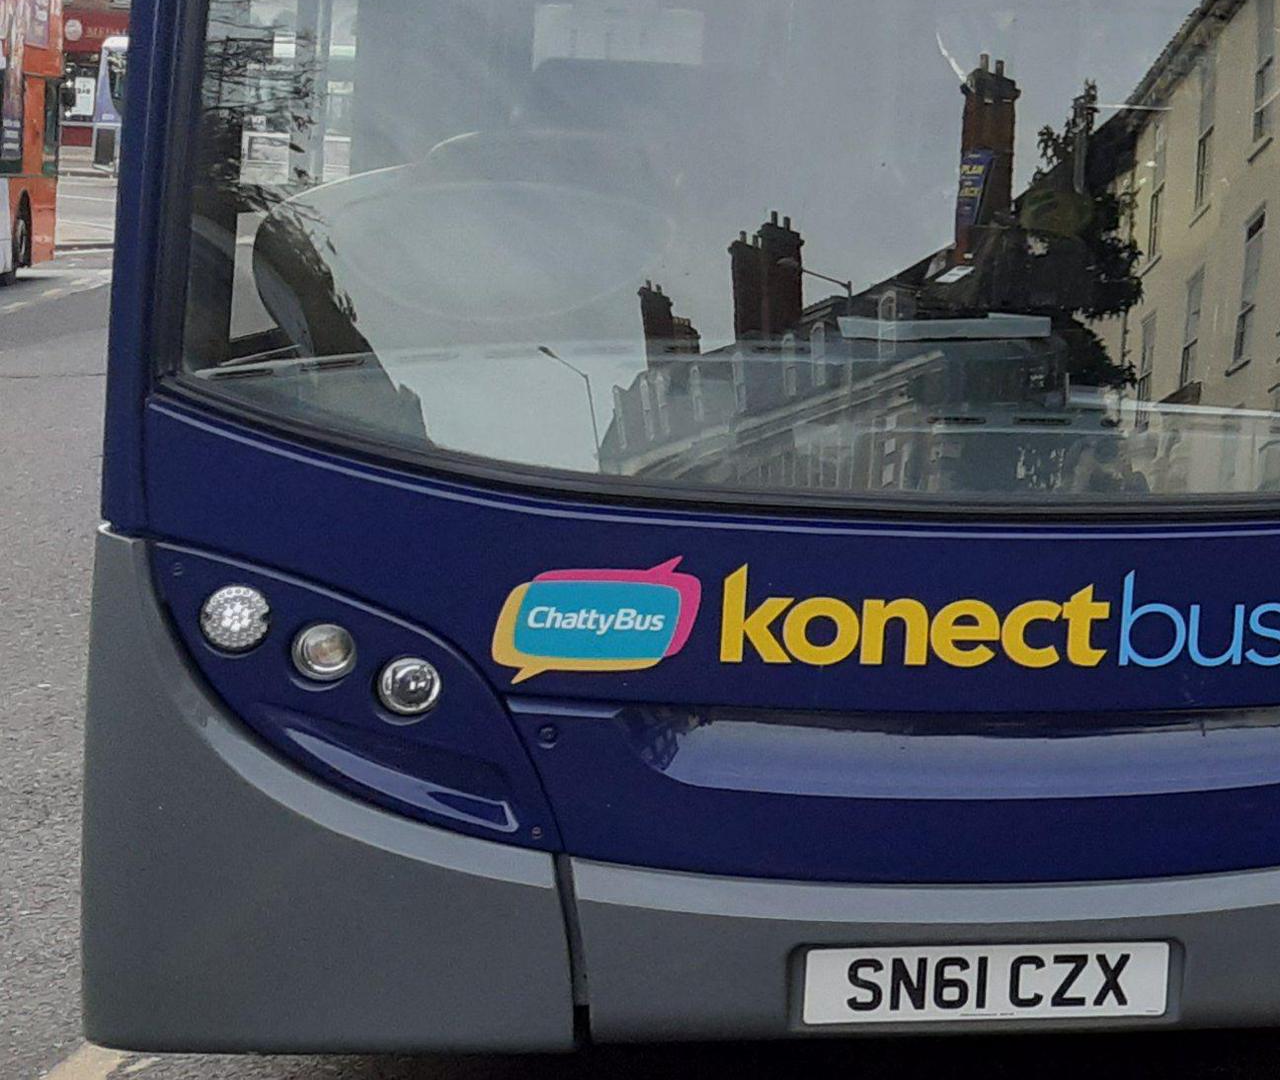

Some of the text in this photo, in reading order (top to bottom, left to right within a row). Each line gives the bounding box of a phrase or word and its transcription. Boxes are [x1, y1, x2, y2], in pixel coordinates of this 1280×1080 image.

[527, 606, 665, 635] ChattyBus
[847, 954, 1131, 1011] SN61 CZX
